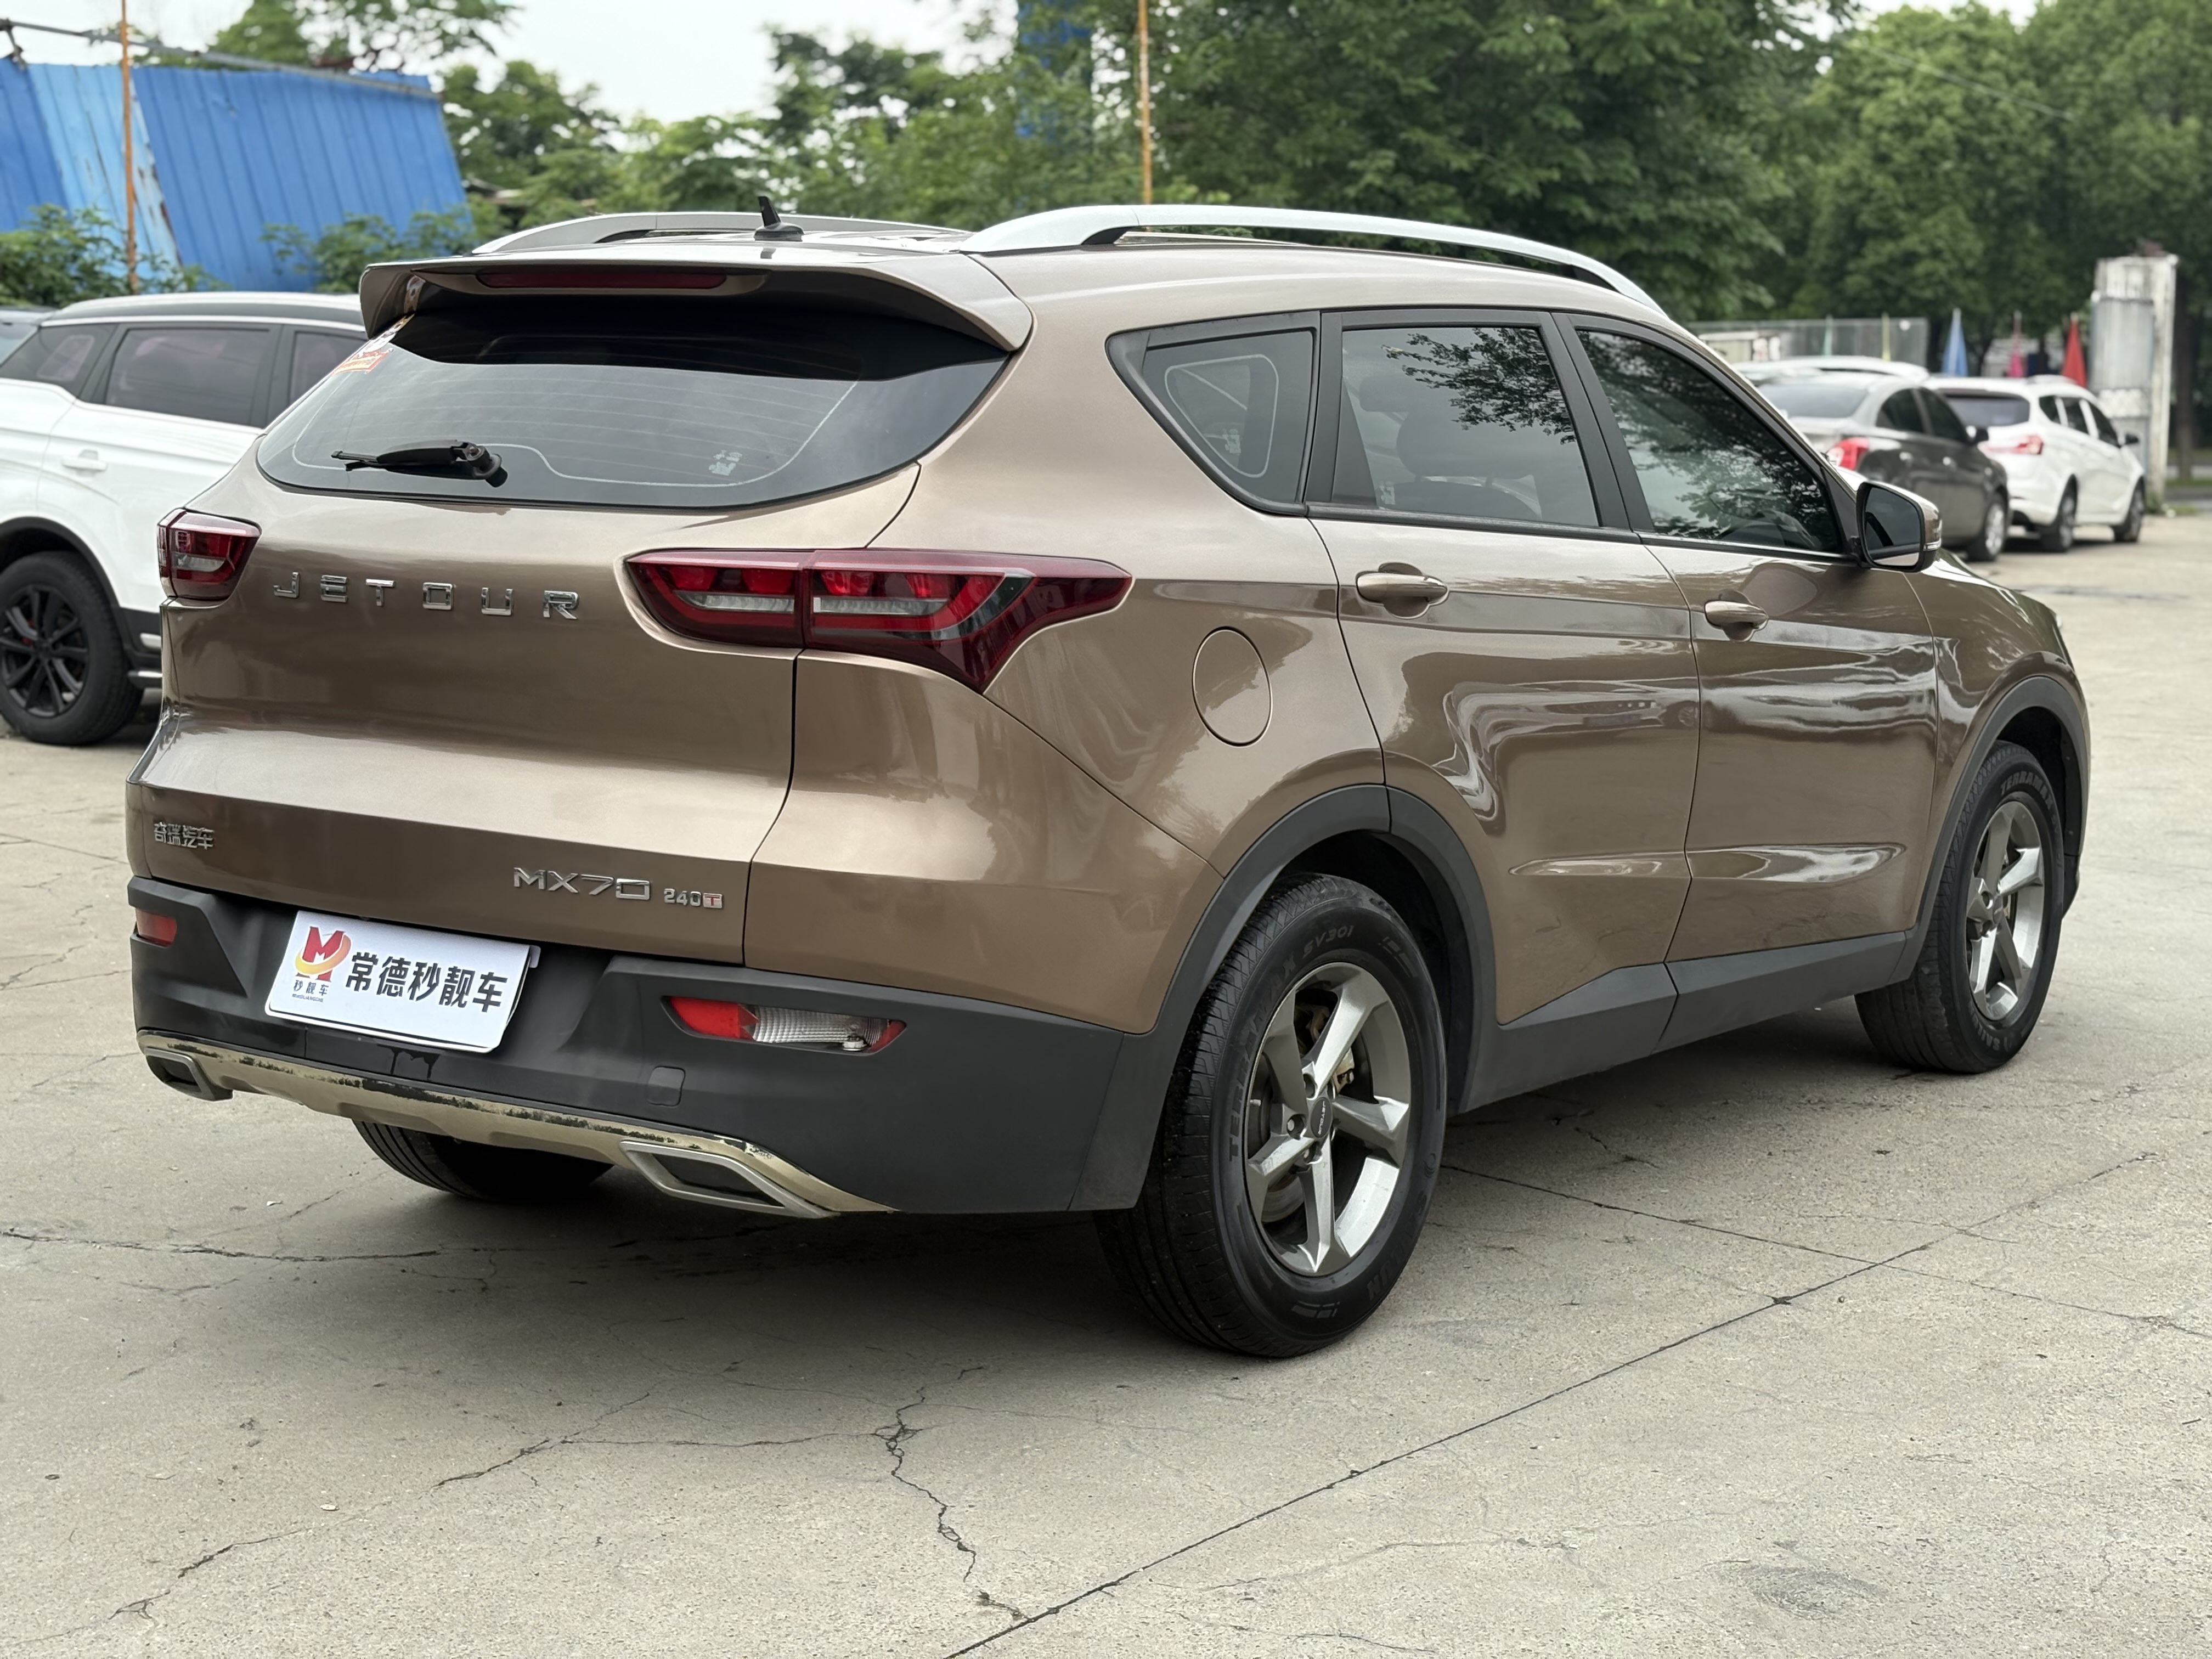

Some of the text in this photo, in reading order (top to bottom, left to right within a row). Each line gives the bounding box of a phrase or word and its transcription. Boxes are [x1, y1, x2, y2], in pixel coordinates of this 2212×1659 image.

[273, 572, 579, 620] JETOUR
[154, 822, 215, 850] 奇瑞汽车
[514, 867, 723, 909] MX70 240T
[346, 952, 508, 1013] 常德秒靓车
